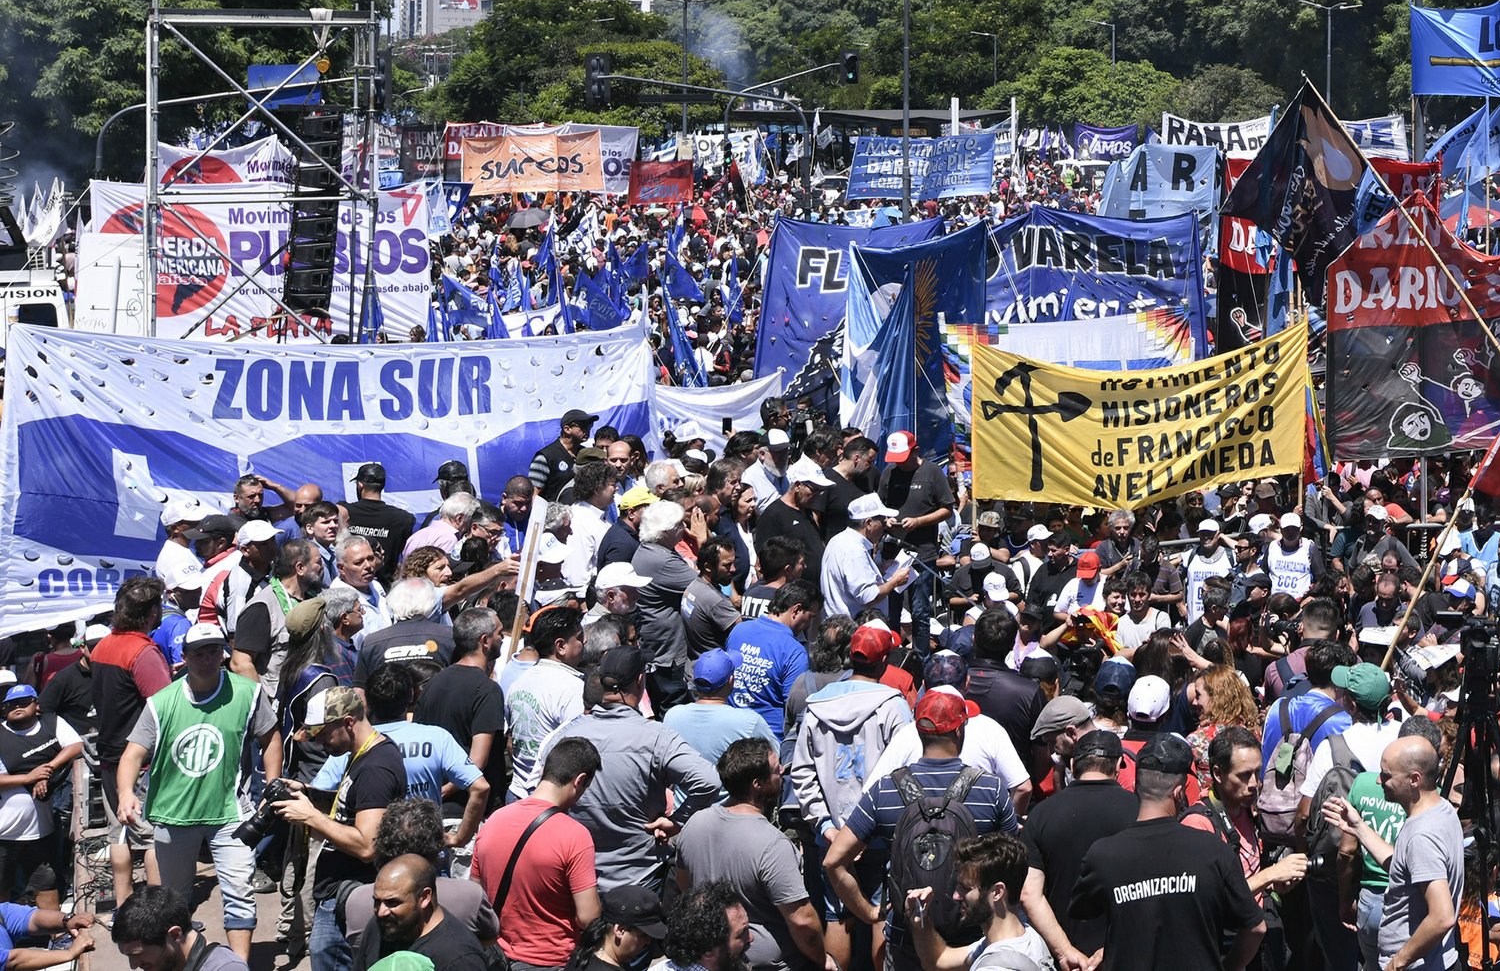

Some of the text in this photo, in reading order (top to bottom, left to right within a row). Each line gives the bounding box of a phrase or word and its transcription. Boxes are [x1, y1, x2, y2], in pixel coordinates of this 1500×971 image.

[1166, 117, 1247, 151] RAMA
[341, 207, 363, 224] de
[156, 258, 226, 276] MERICANA
[229, 228, 429, 278] PUBLOS
[1010, 224, 1177, 280] VARELA
[377, 282, 400, 294] esde
[402, 282, 431, 296] abajo
[1334, 264, 1461, 314] DARIO
[205, 314, 241, 337] LA
[213, 356, 492, 421] ZONA SUR
[1102, 372, 1278, 428] MISIONEROS
[1091, 405, 1274, 467] de FRANCISCO
[1093, 438, 1275, 501] AVELLANEDA
[1277, 575, 1298, 590] CCC
[740, 643, 761, 657] RAMA
[400, 741, 433, 759] ADO
[406, 781, 431, 793] ENTO
[1114, 872, 1197, 904] ORGANIZACIÓN
